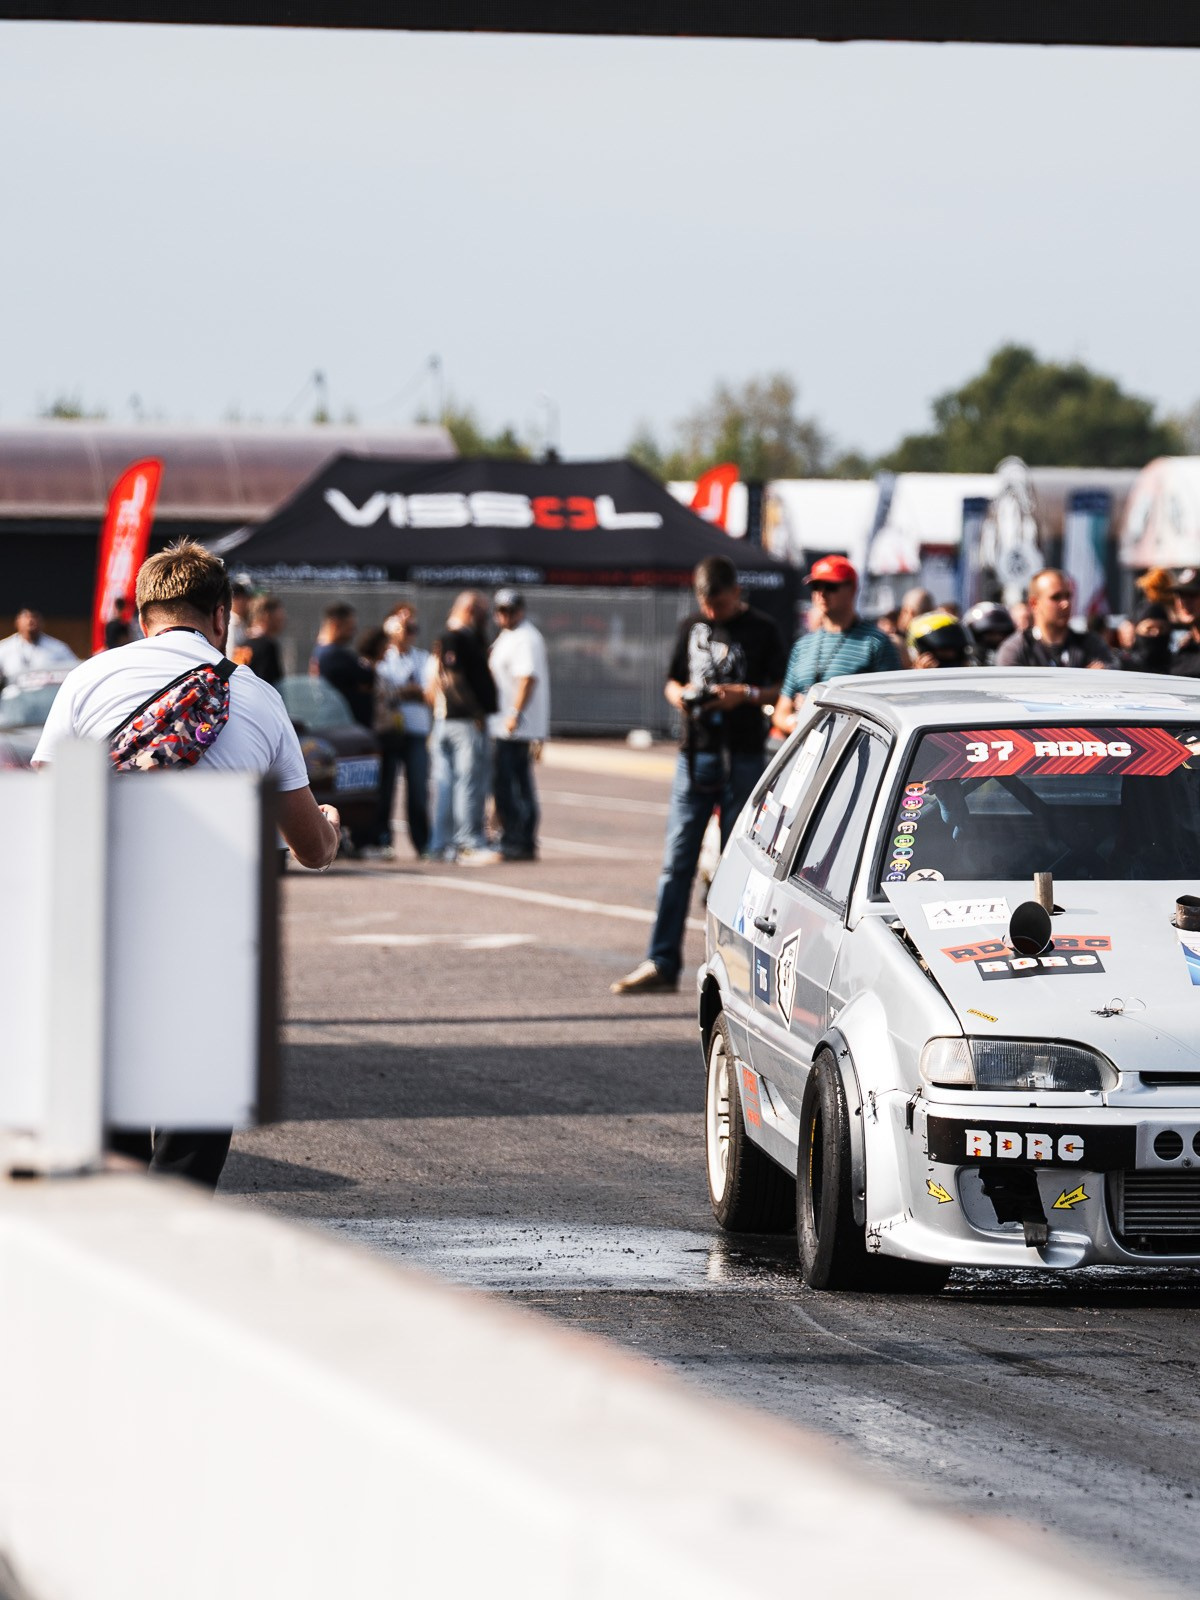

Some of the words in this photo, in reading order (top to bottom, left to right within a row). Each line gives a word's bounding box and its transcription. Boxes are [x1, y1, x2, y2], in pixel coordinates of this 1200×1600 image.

[965, 740, 1014, 763] 37
[1033, 740, 1132, 757] RDRC
[933, 903, 1005, 918] ATT
[978, 953, 1098, 973] RDRC
[964, 1129, 1084, 1162] RDRC
